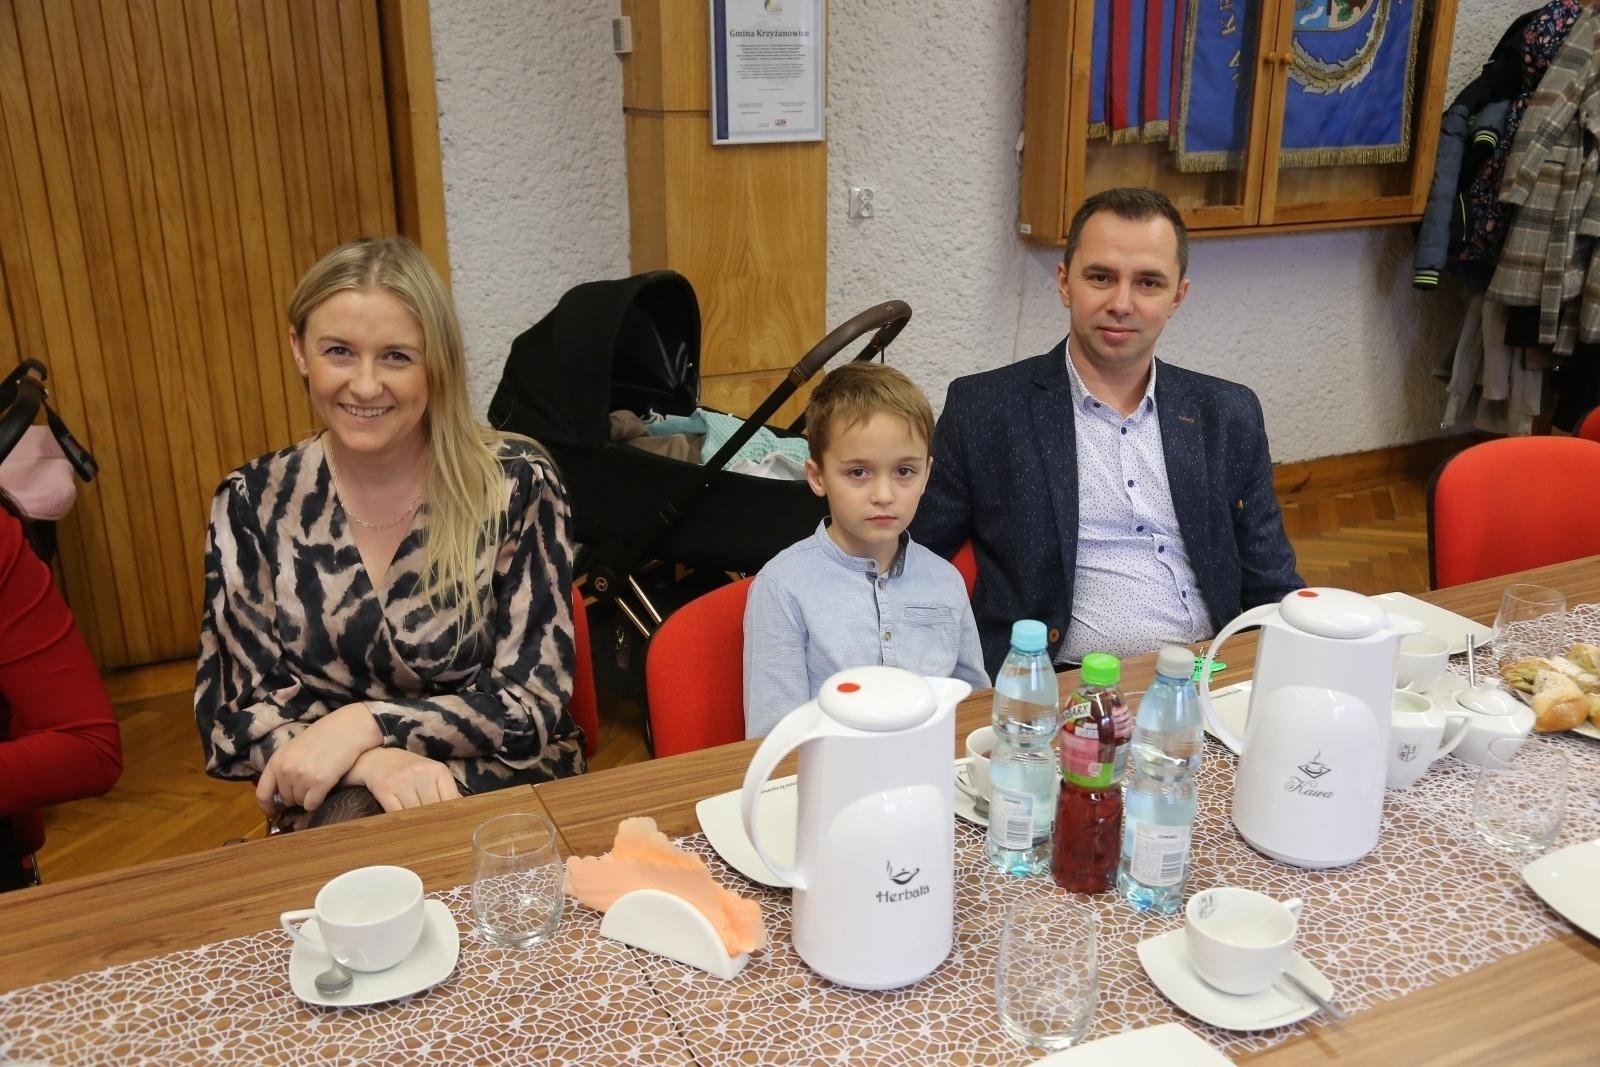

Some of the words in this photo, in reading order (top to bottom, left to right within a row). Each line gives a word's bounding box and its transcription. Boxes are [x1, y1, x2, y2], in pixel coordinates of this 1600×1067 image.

[729, 29, 755, 38] Gmina
[756, 28, 810, 39] Krzyżanowice
[1284, 776, 1334, 798] Kawa
[875, 884, 930, 903] Herbata
